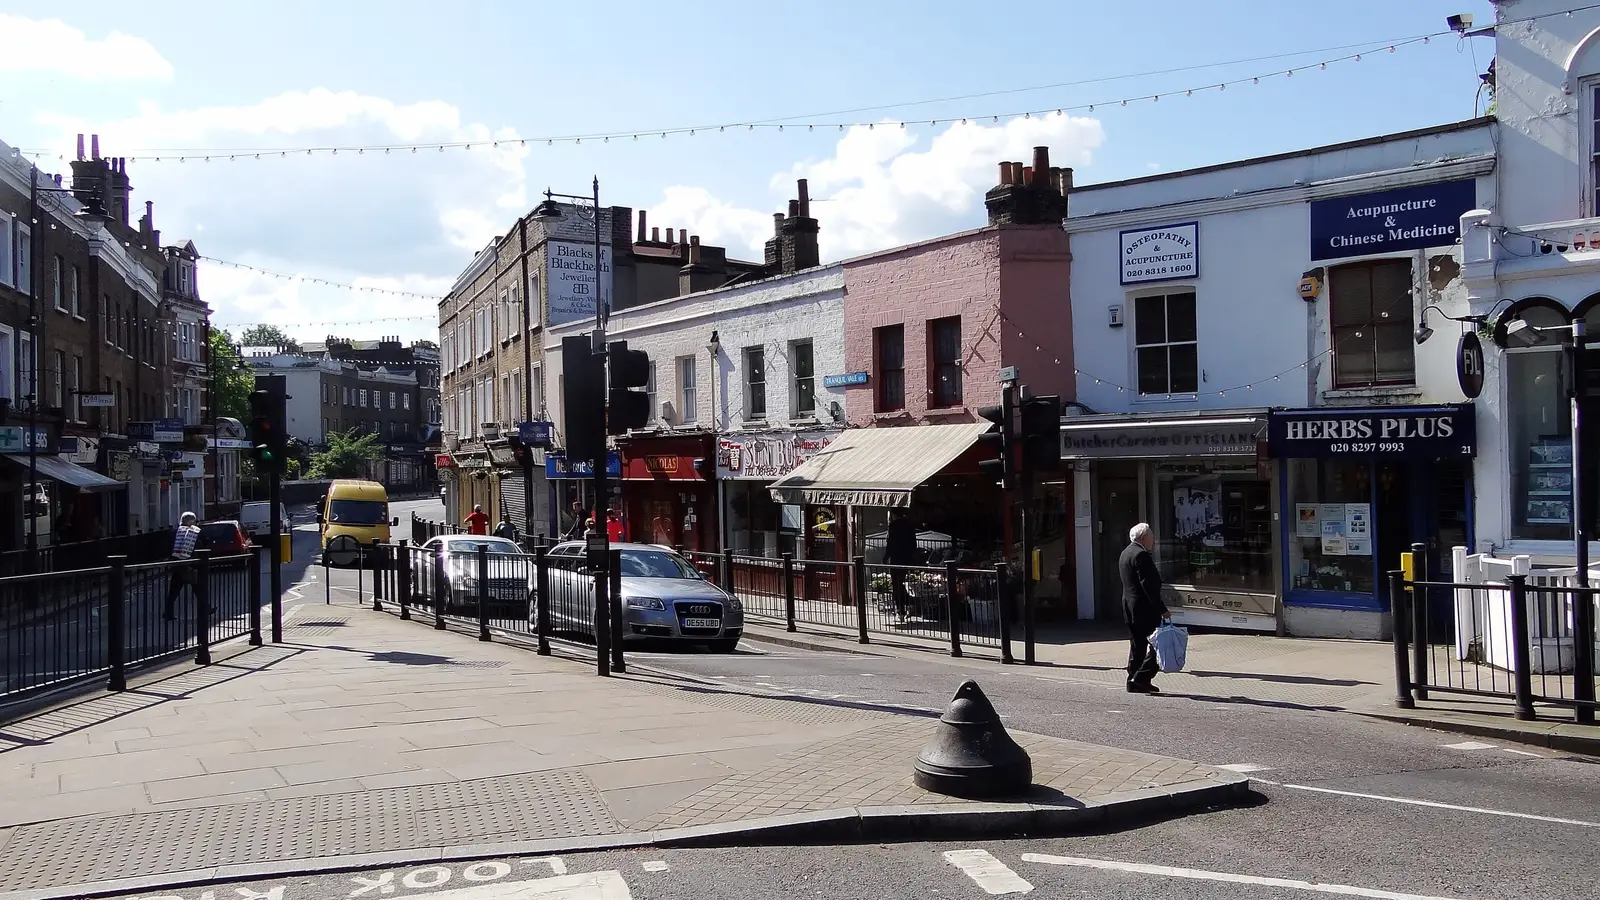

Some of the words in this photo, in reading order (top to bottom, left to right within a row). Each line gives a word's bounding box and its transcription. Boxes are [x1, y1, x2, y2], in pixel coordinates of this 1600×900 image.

[1347, 198, 1437, 219] Acupuncture
[1384, 216, 1396, 228] &
[1330, 234, 1384, 248] Chinese
[1389, 224, 1455, 241] Medicine
[1126, 232, 1192, 255] OSTEOPATHY
[557, 245, 593, 259] Blacks
[1125, 252, 1193, 265] ACUPUNCTURE
[551, 257, 610, 273] Blackheth
[1145, 267, 1167, 275] 8318
[1170, 264, 1192, 273] 1600
[560, 272, 597, 283] Jeweller
[1286, 418, 1373, 440] HERBS
[1379, 416, 1453, 438] PLUS
[1172, 432, 1257, 446] OPTICIANS
[1330, 443, 1349, 453] 020
[1351, 443, 1376, 452] 8297
[1379, 442, 1405, 452] 9993
[1461, 445, 1472, 454] 21
[649, 458, 677, 470] NICOLAS
